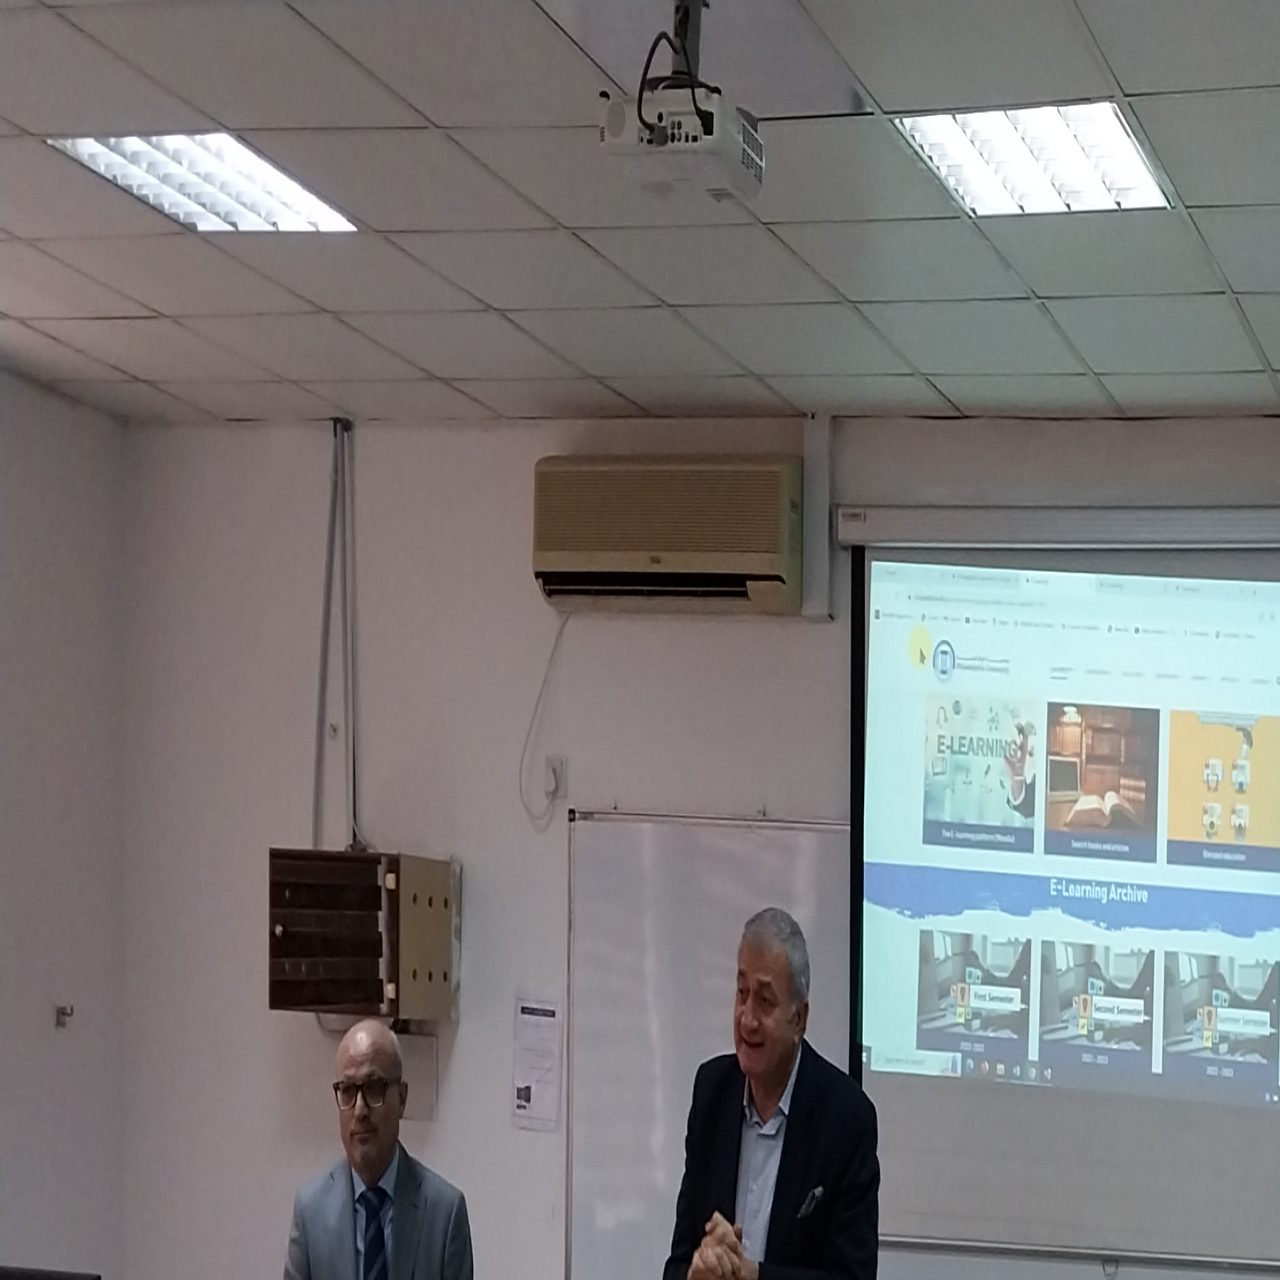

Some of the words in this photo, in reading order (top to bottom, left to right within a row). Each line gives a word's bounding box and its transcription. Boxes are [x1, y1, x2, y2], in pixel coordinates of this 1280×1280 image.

[937, 734, 1019, 759] E-LEARNING
[1050, 878, 1107, 904] E-Learning
[1109, 883, 1149, 904] Archive
[1094, 1002, 1115, 1014] Second
